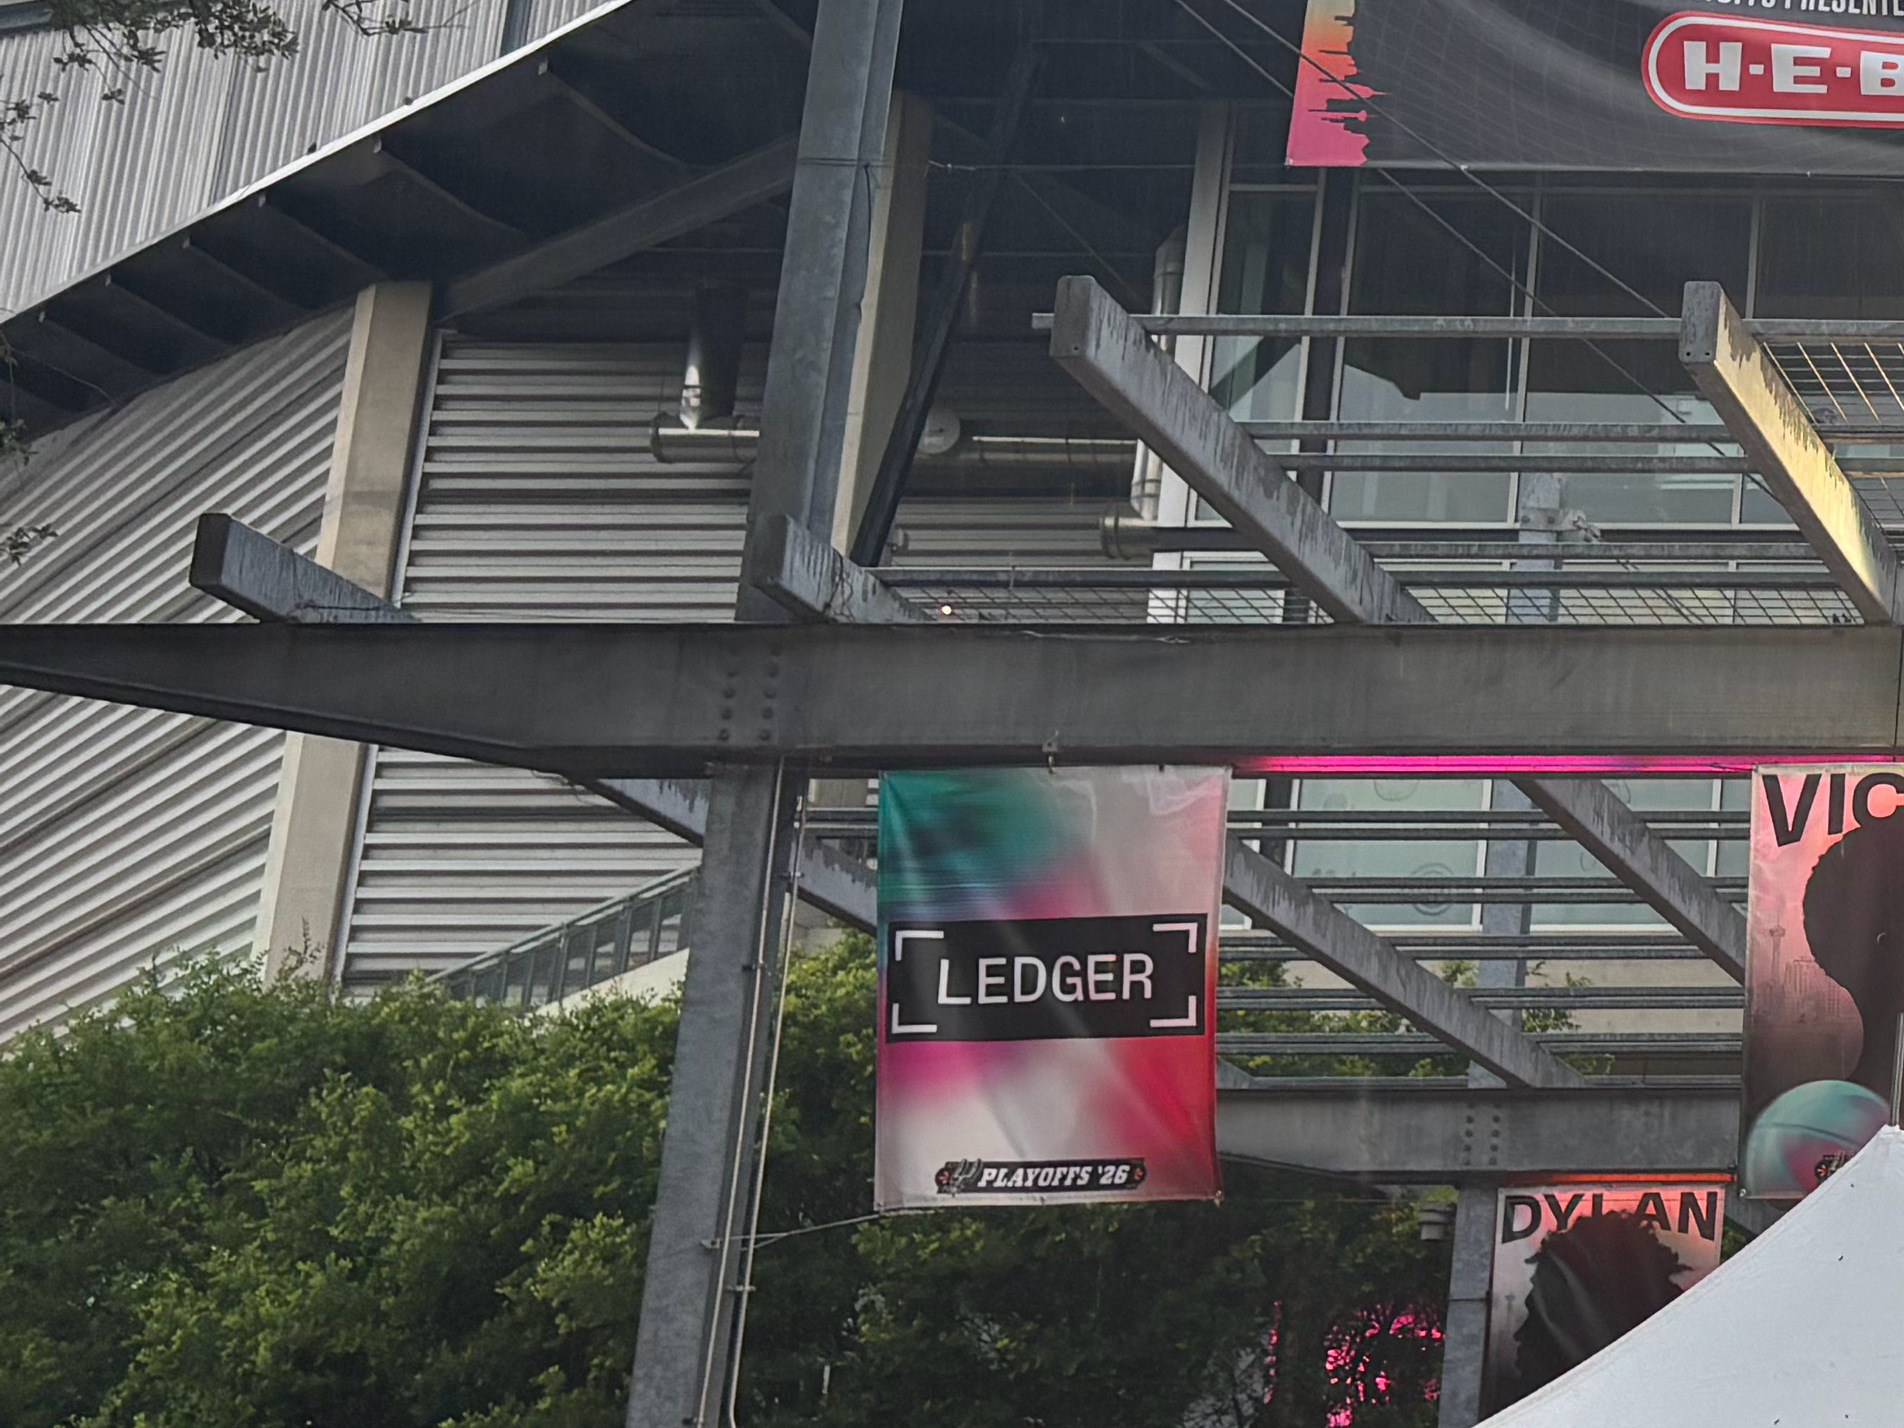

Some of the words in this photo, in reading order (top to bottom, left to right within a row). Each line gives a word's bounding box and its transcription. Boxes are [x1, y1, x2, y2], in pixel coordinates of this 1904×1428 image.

[937, 953, 1155, 1005] LEDGER
[977, 1165, 1092, 1188] PLAYOFFS
[1097, 1165, 1130, 1186] '26
